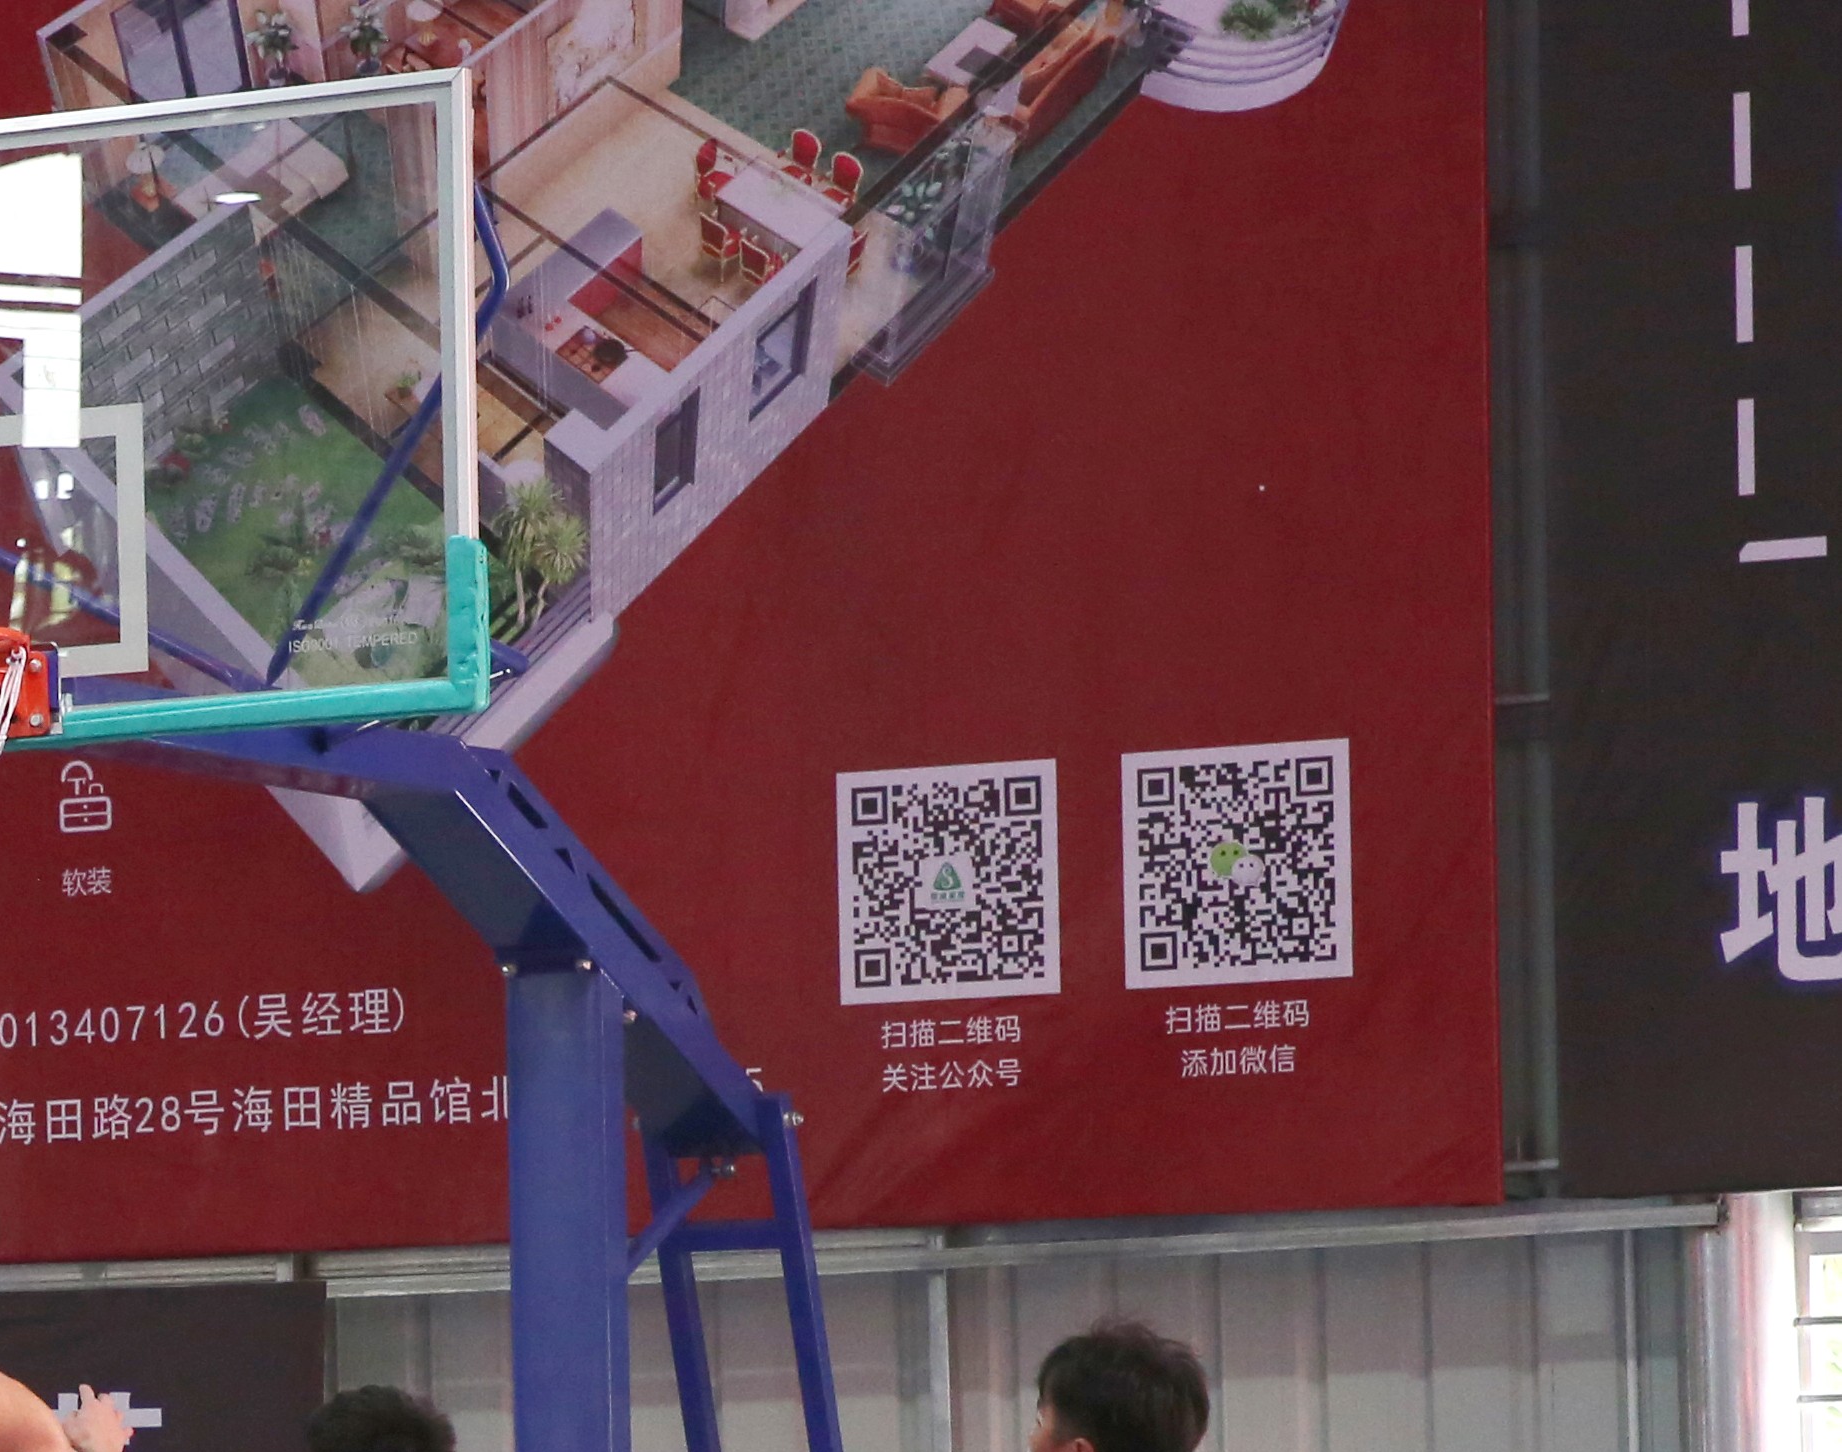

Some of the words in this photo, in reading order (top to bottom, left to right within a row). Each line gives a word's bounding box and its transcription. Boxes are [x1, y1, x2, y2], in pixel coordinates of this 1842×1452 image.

[62, 865, 112, 897] 软装
[881, 1014, 1023, 1049] 扫描二维码
[1165, 999, 1310, 1035] 扫描二维码
[881, 1058, 1023, 1093] 关注公众号
[1180, 1043, 1296, 1078] 添加微信
